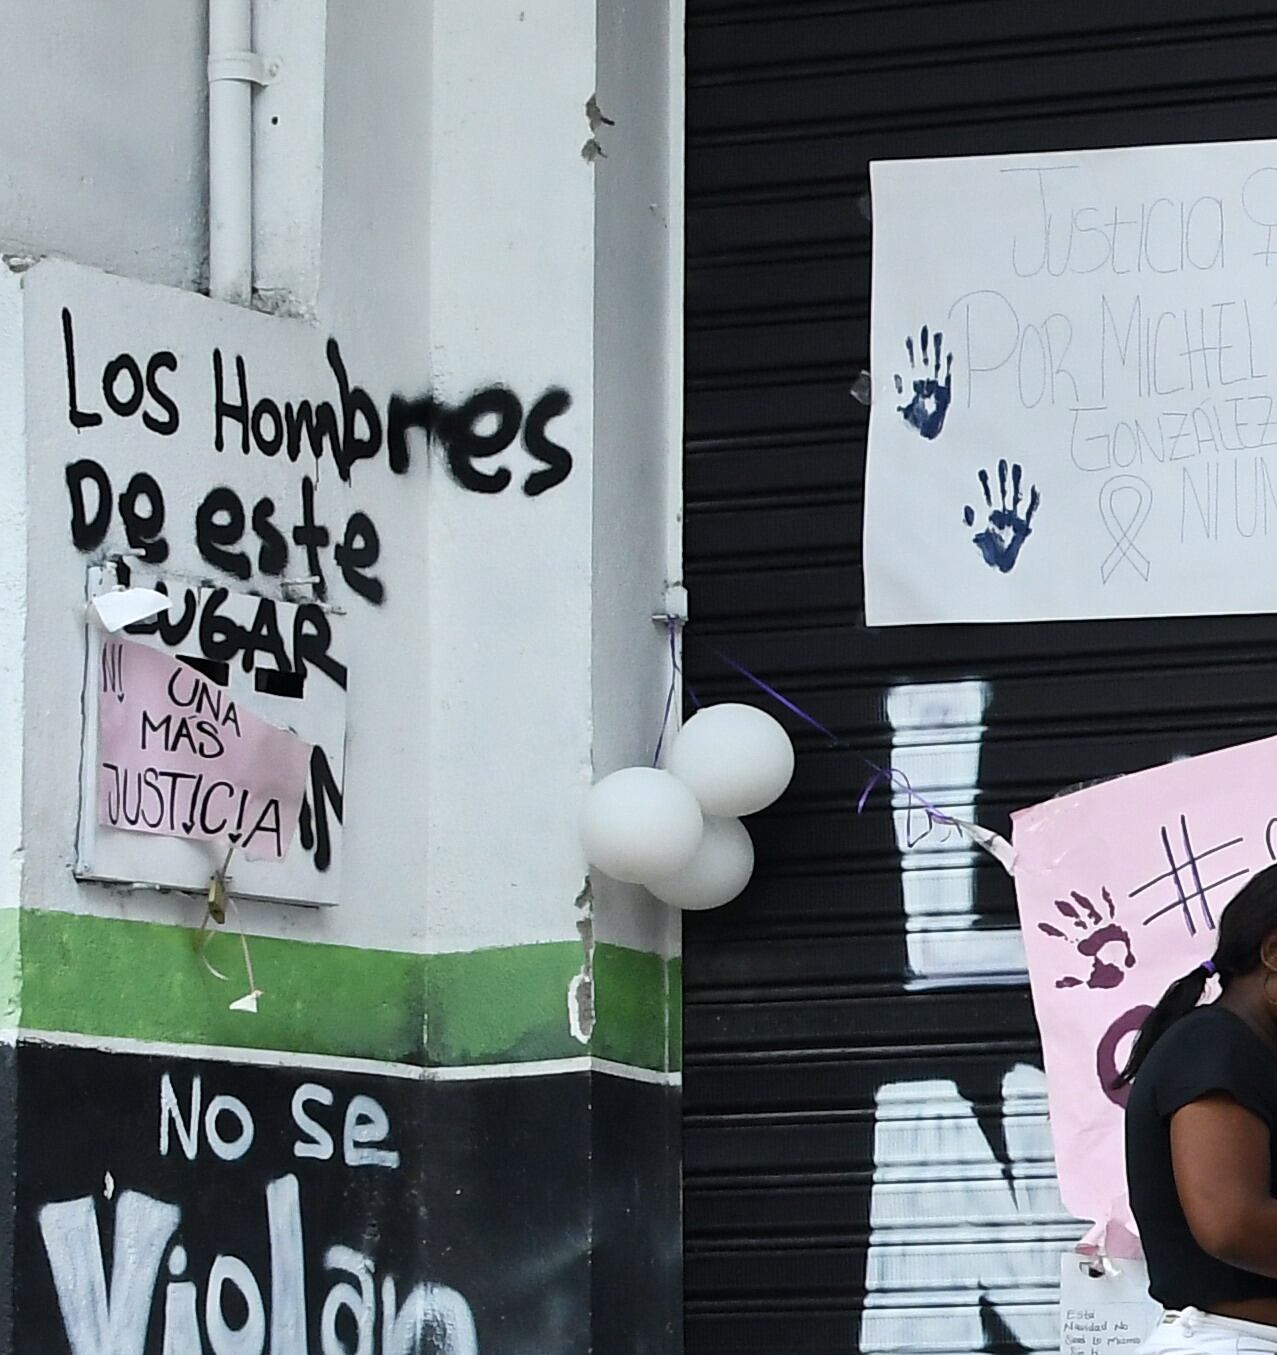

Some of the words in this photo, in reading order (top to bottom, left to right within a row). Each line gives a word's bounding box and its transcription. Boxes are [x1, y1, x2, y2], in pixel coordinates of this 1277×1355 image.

[1100, 293, 1265, 400] MICHEL
[213, 336, 574, 498] Hombres
[195, 477, 384, 605] este
[168, 667, 242, 738] UNA
